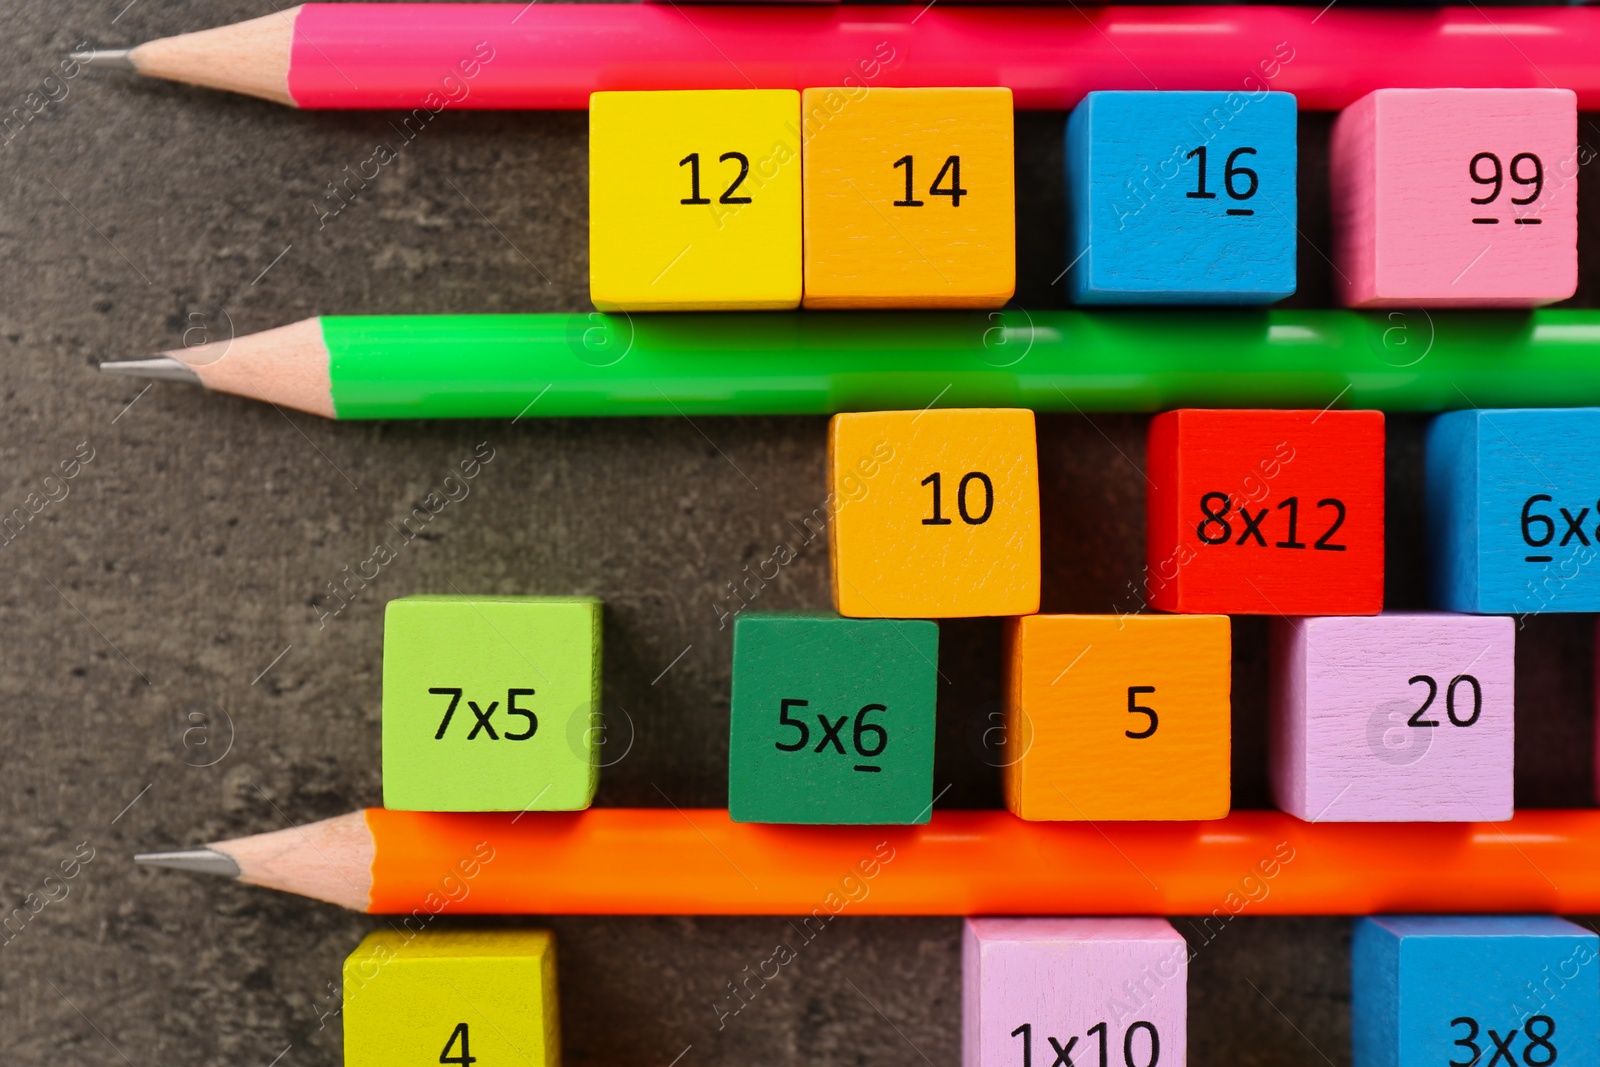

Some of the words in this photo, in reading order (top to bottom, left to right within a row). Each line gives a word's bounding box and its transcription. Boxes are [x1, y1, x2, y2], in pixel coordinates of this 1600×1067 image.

[679, 151, 753, 205] 12
[893, 155, 968, 208] 14
[1186, 145, 1259, 216] 16
[1469, 152, 1543, 225] 99
[921, 471, 994, 526] 10
[1196, 491, 1347, 552] 8x12
[1520, 493, 1600, 563] 6x
[428, 687, 538, 741] 7x5
[1125, 685, 1159, 740] 5
[1407, 674, 1482, 728] 20
[775, 698, 888, 773] 5x6
[439, 1022, 477, 1067] 4
[1010, 1020, 1160, 1067] 1x10
[1449, 1014, 1557, 1067] 3x8
